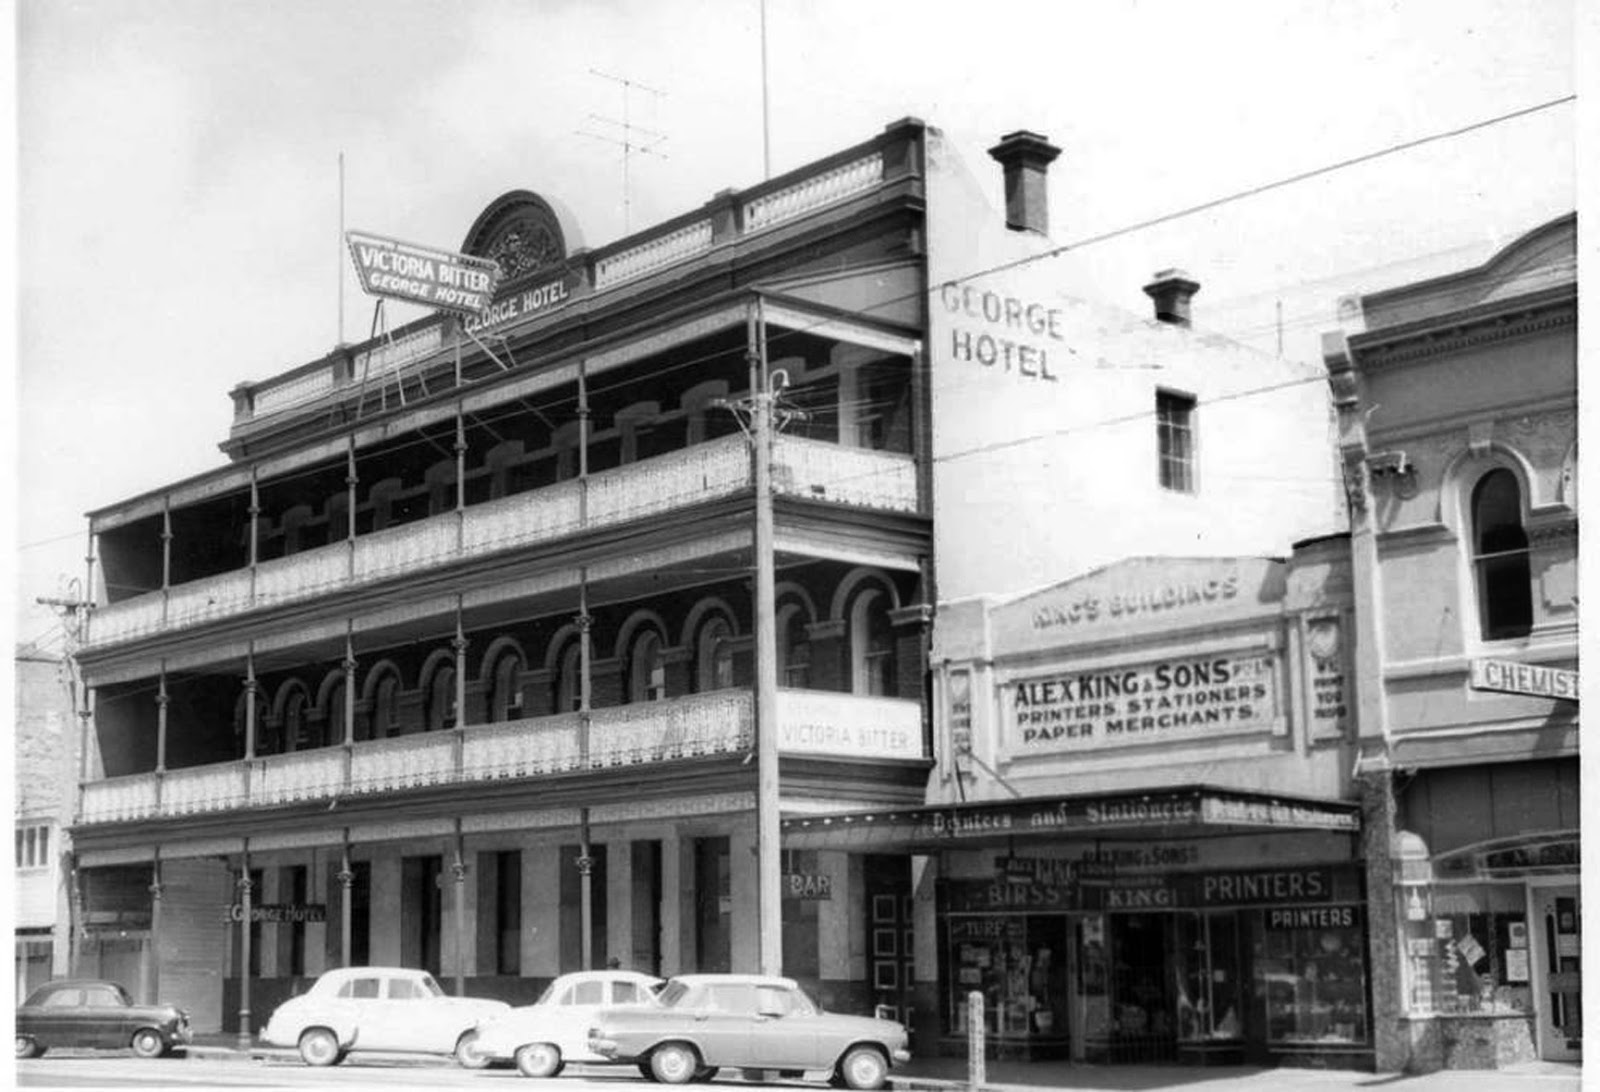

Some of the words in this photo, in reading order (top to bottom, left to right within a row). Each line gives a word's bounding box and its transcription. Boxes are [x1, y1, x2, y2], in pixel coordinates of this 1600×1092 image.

[360, 245, 434, 281] VICTORIA
[439, 265, 490, 293] BITTER
[370, 272, 430, 297] GEORGE
[435, 287, 483, 309] HOTEL
[464, 297, 519, 331] GEORGE
[522, 281, 568, 313] HOTEL
[941, 281, 1063, 340] GEORGE
[952, 328, 1057, 381] HOTEL
[1015, 681, 1074, 707] ALEX
[1078, 671, 1139, 700] KING
[1155, 659, 1230, 691] SONS
[1017, 700, 1117, 726] PRINTERS
[1126, 683, 1267, 714] STATIONERS
[776, 721, 853, 744] VICTORIA
[858, 727, 908, 749] BITTER
[1023, 722, 1093, 743] PAPER
[790, 873, 831, 899] BAR
[1107, 888, 1171, 908] KING
[1271, 908, 1353, 929] PRINTERS
